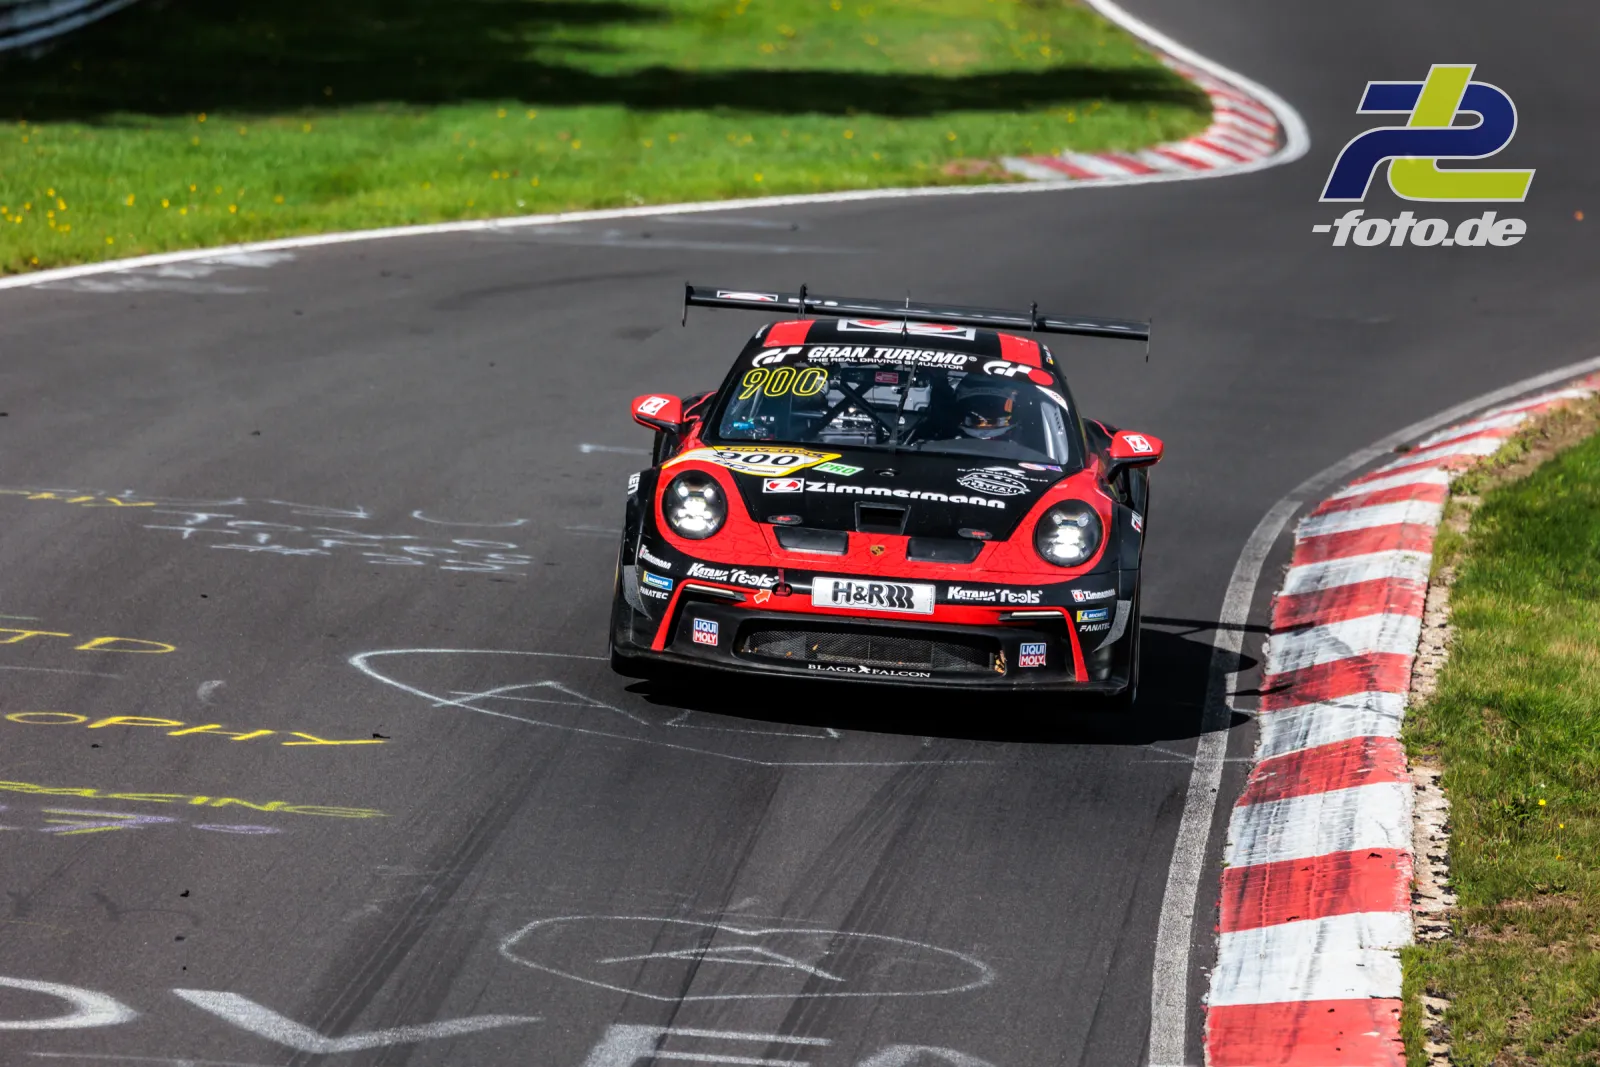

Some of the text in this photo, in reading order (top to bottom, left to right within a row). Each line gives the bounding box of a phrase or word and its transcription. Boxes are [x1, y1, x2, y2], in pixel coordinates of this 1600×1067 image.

[807, 346, 873, 359] GRAN
[904, 359, 963, 370] SIMULATOR
[738, 366, 829, 400] 900
[712, 451, 800, 466] 900
[818, 463, 858, 475] PRO
[805, 481, 1006, 509] Zimmermann
[686, 562, 729, 581] KATANA
[947, 586, 996, 602] KATANA
[694, 620, 718, 634] LIQUI
[694, 631, 718, 645] MOLY
[1021, 644, 1045, 655] LIQUI
[1020, 655, 1045, 666] MOLY
[808, 664, 931, 678] BLACK FALCON
